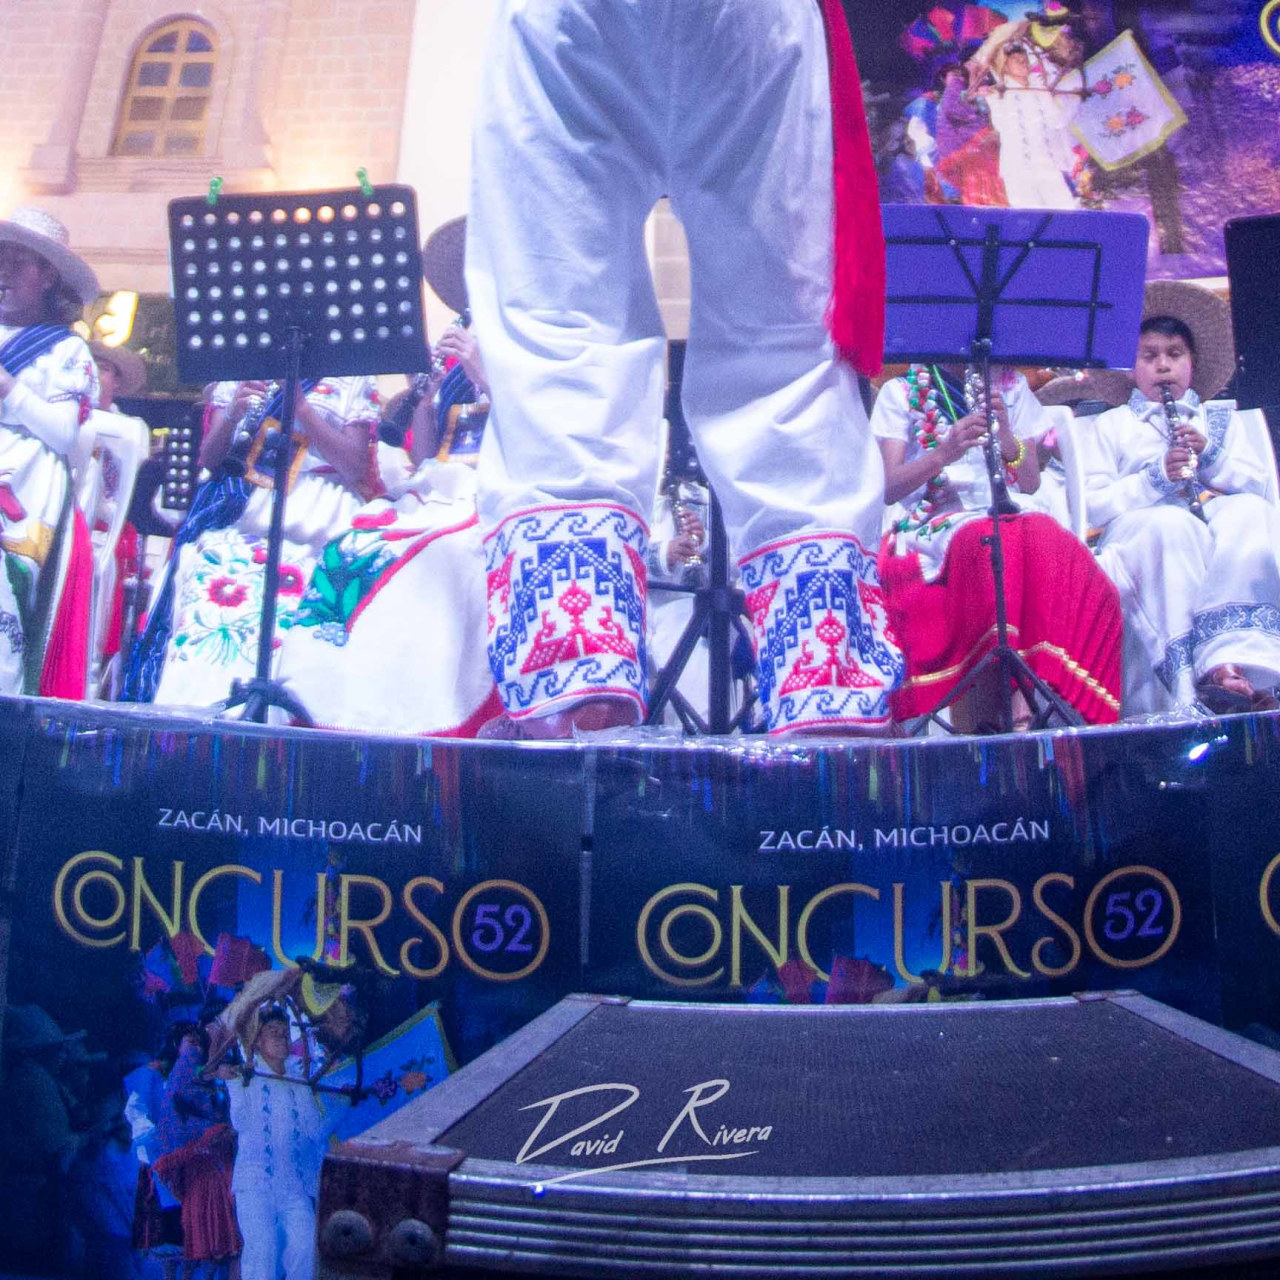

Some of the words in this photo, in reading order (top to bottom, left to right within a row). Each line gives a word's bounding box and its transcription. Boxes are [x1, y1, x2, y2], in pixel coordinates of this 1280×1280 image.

[158, 808, 249, 837] ZACÁN,
[258, 816, 422, 843] MICHOACÁN
[758, 826, 864, 852] ZACÁN,
[875, 817, 1050, 848] MICHOACÁN
[471, 903, 534, 953] 52
[1104, 888, 1165, 941] 52
